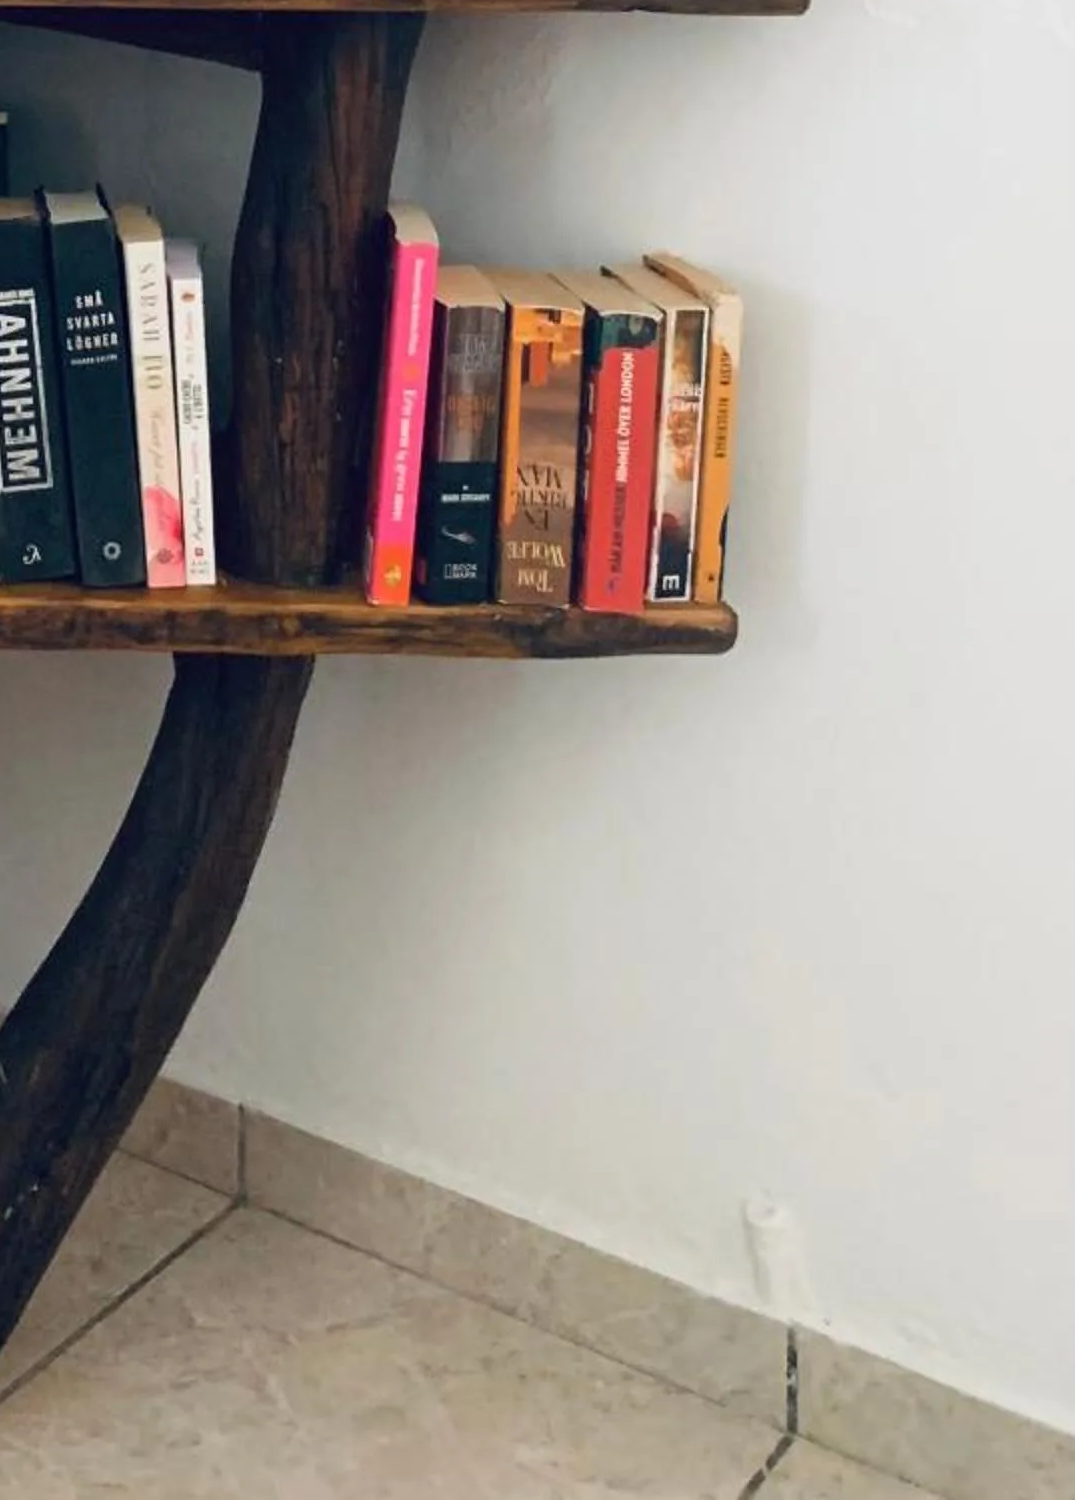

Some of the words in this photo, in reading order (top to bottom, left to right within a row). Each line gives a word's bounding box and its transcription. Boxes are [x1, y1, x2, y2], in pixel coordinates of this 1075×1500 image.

[75, 290, 104, 308] SMÅ
[140, 262, 165, 344] SARAH
[66, 313, 116, 329] SVARTA
[66, 333, 119, 352] LÖGNER
[619, 351, 635, 404] LONDON
[506, 540, 566, 567] WOLFE
[517, 568, 553, 593] TOM
